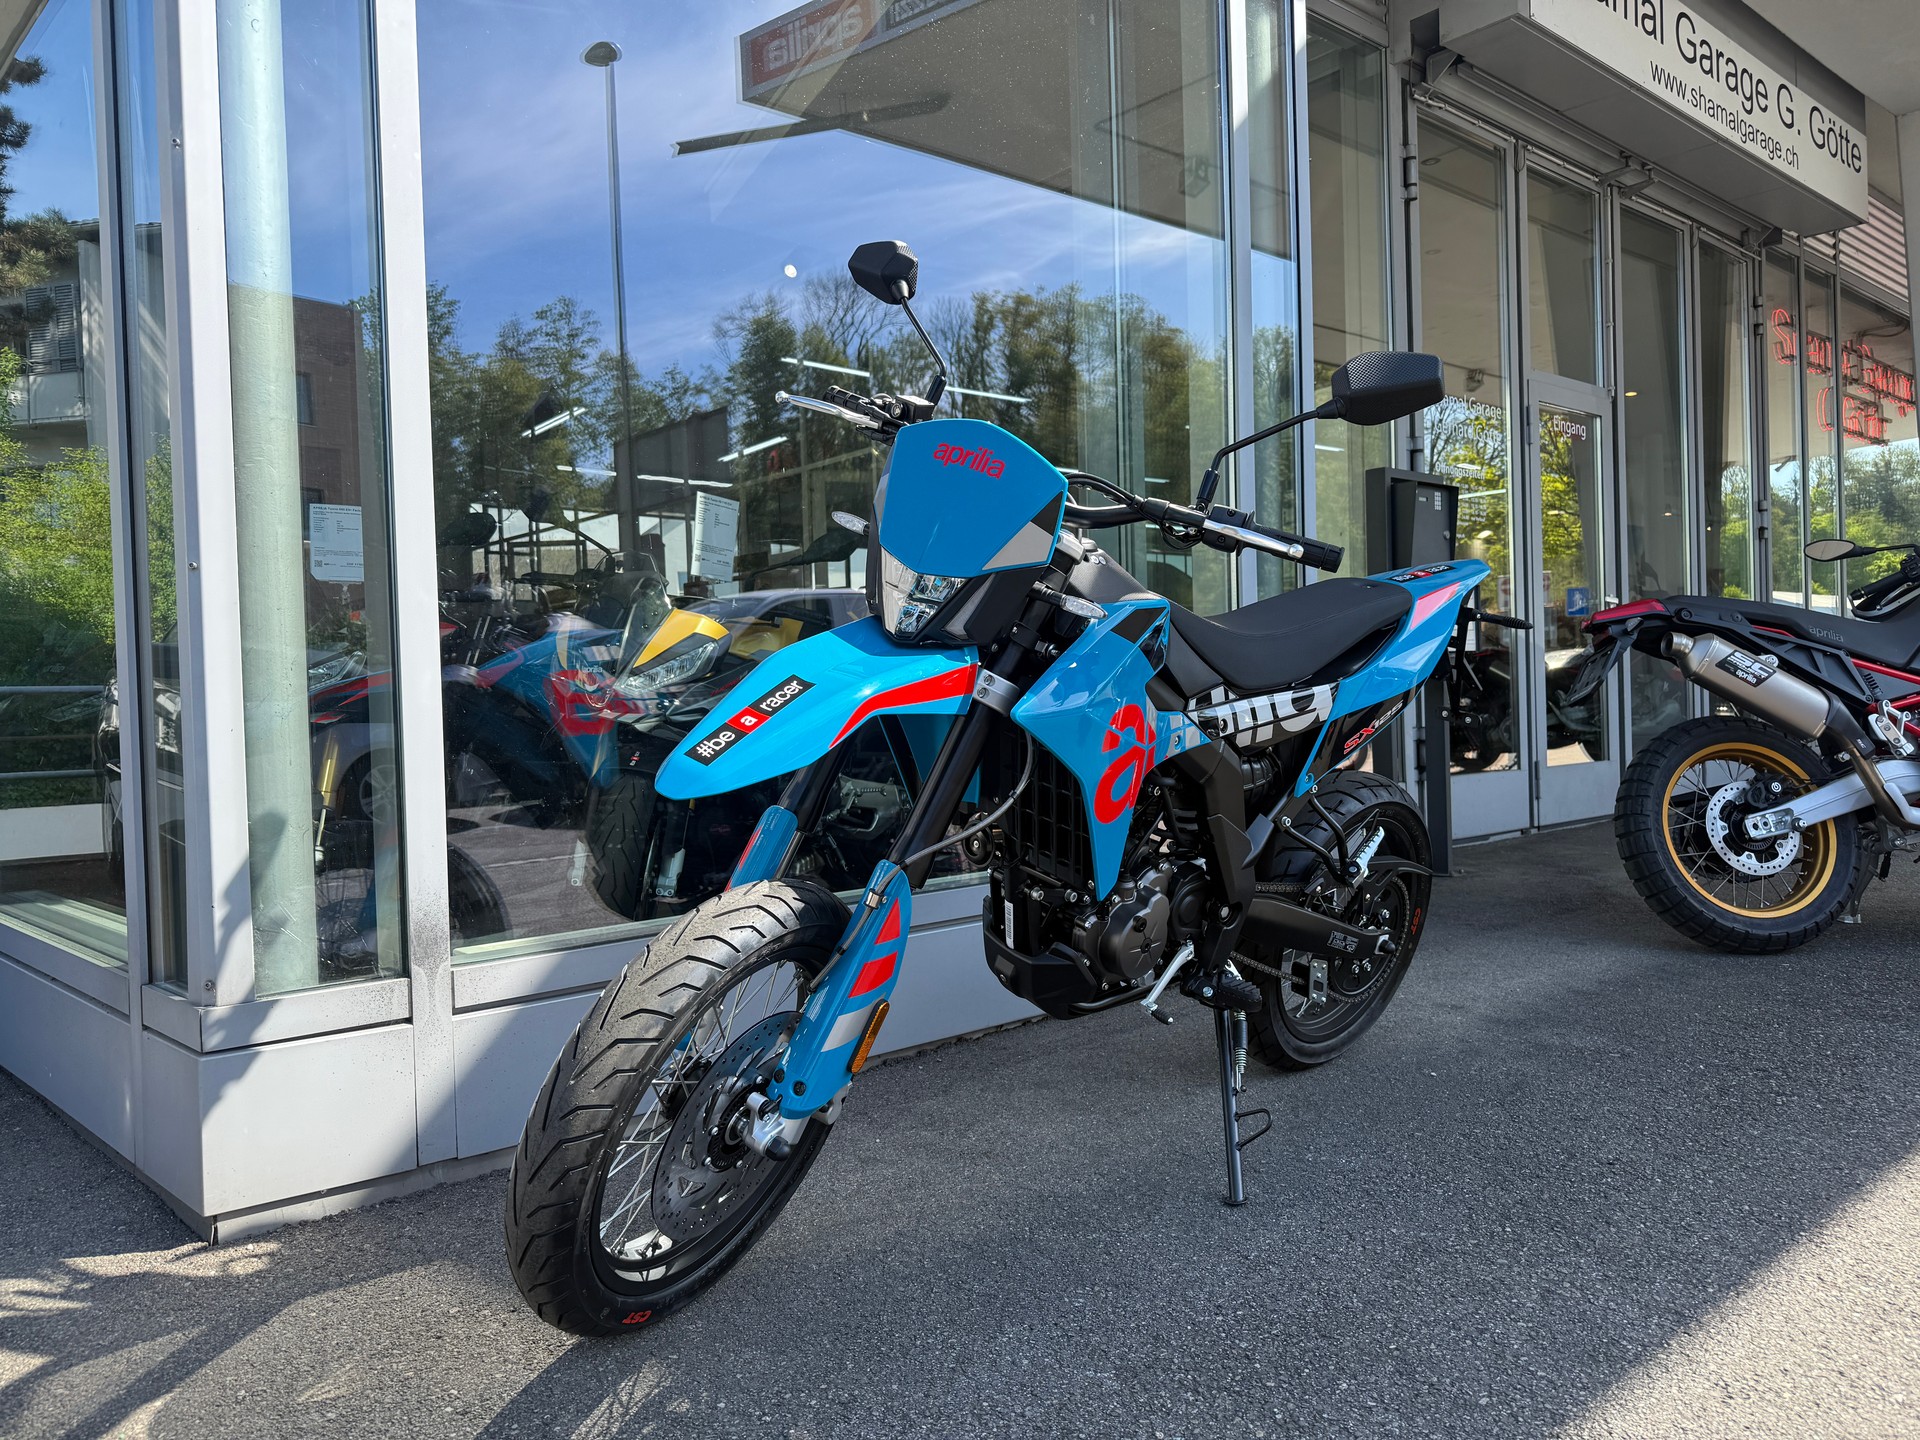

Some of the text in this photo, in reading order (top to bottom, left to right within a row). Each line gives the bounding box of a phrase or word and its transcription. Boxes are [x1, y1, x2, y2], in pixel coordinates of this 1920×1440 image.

[1675, 12, 1768, 115] Garage
[1776, 83, 1801, 136] G.
[1809, 105, 1862, 174] Götte
[1650, 60, 1799, 170] www.shamalgarage.ch
[1468, 397, 1502, 421] Garage
[1553, 415, 1586, 440] Eingang
[933, 442, 1006, 480] aprilia
[1809, 625, 1844, 642] aprilia
[1735, 669, 1757, 684] aprilia
[696, 731, 736, 758] #be
[740, 715, 759, 726] a
[760, 680, 804, 712] racer
[1411, 907, 1422, 936] CST
[622, 1310, 652, 1325] CST
